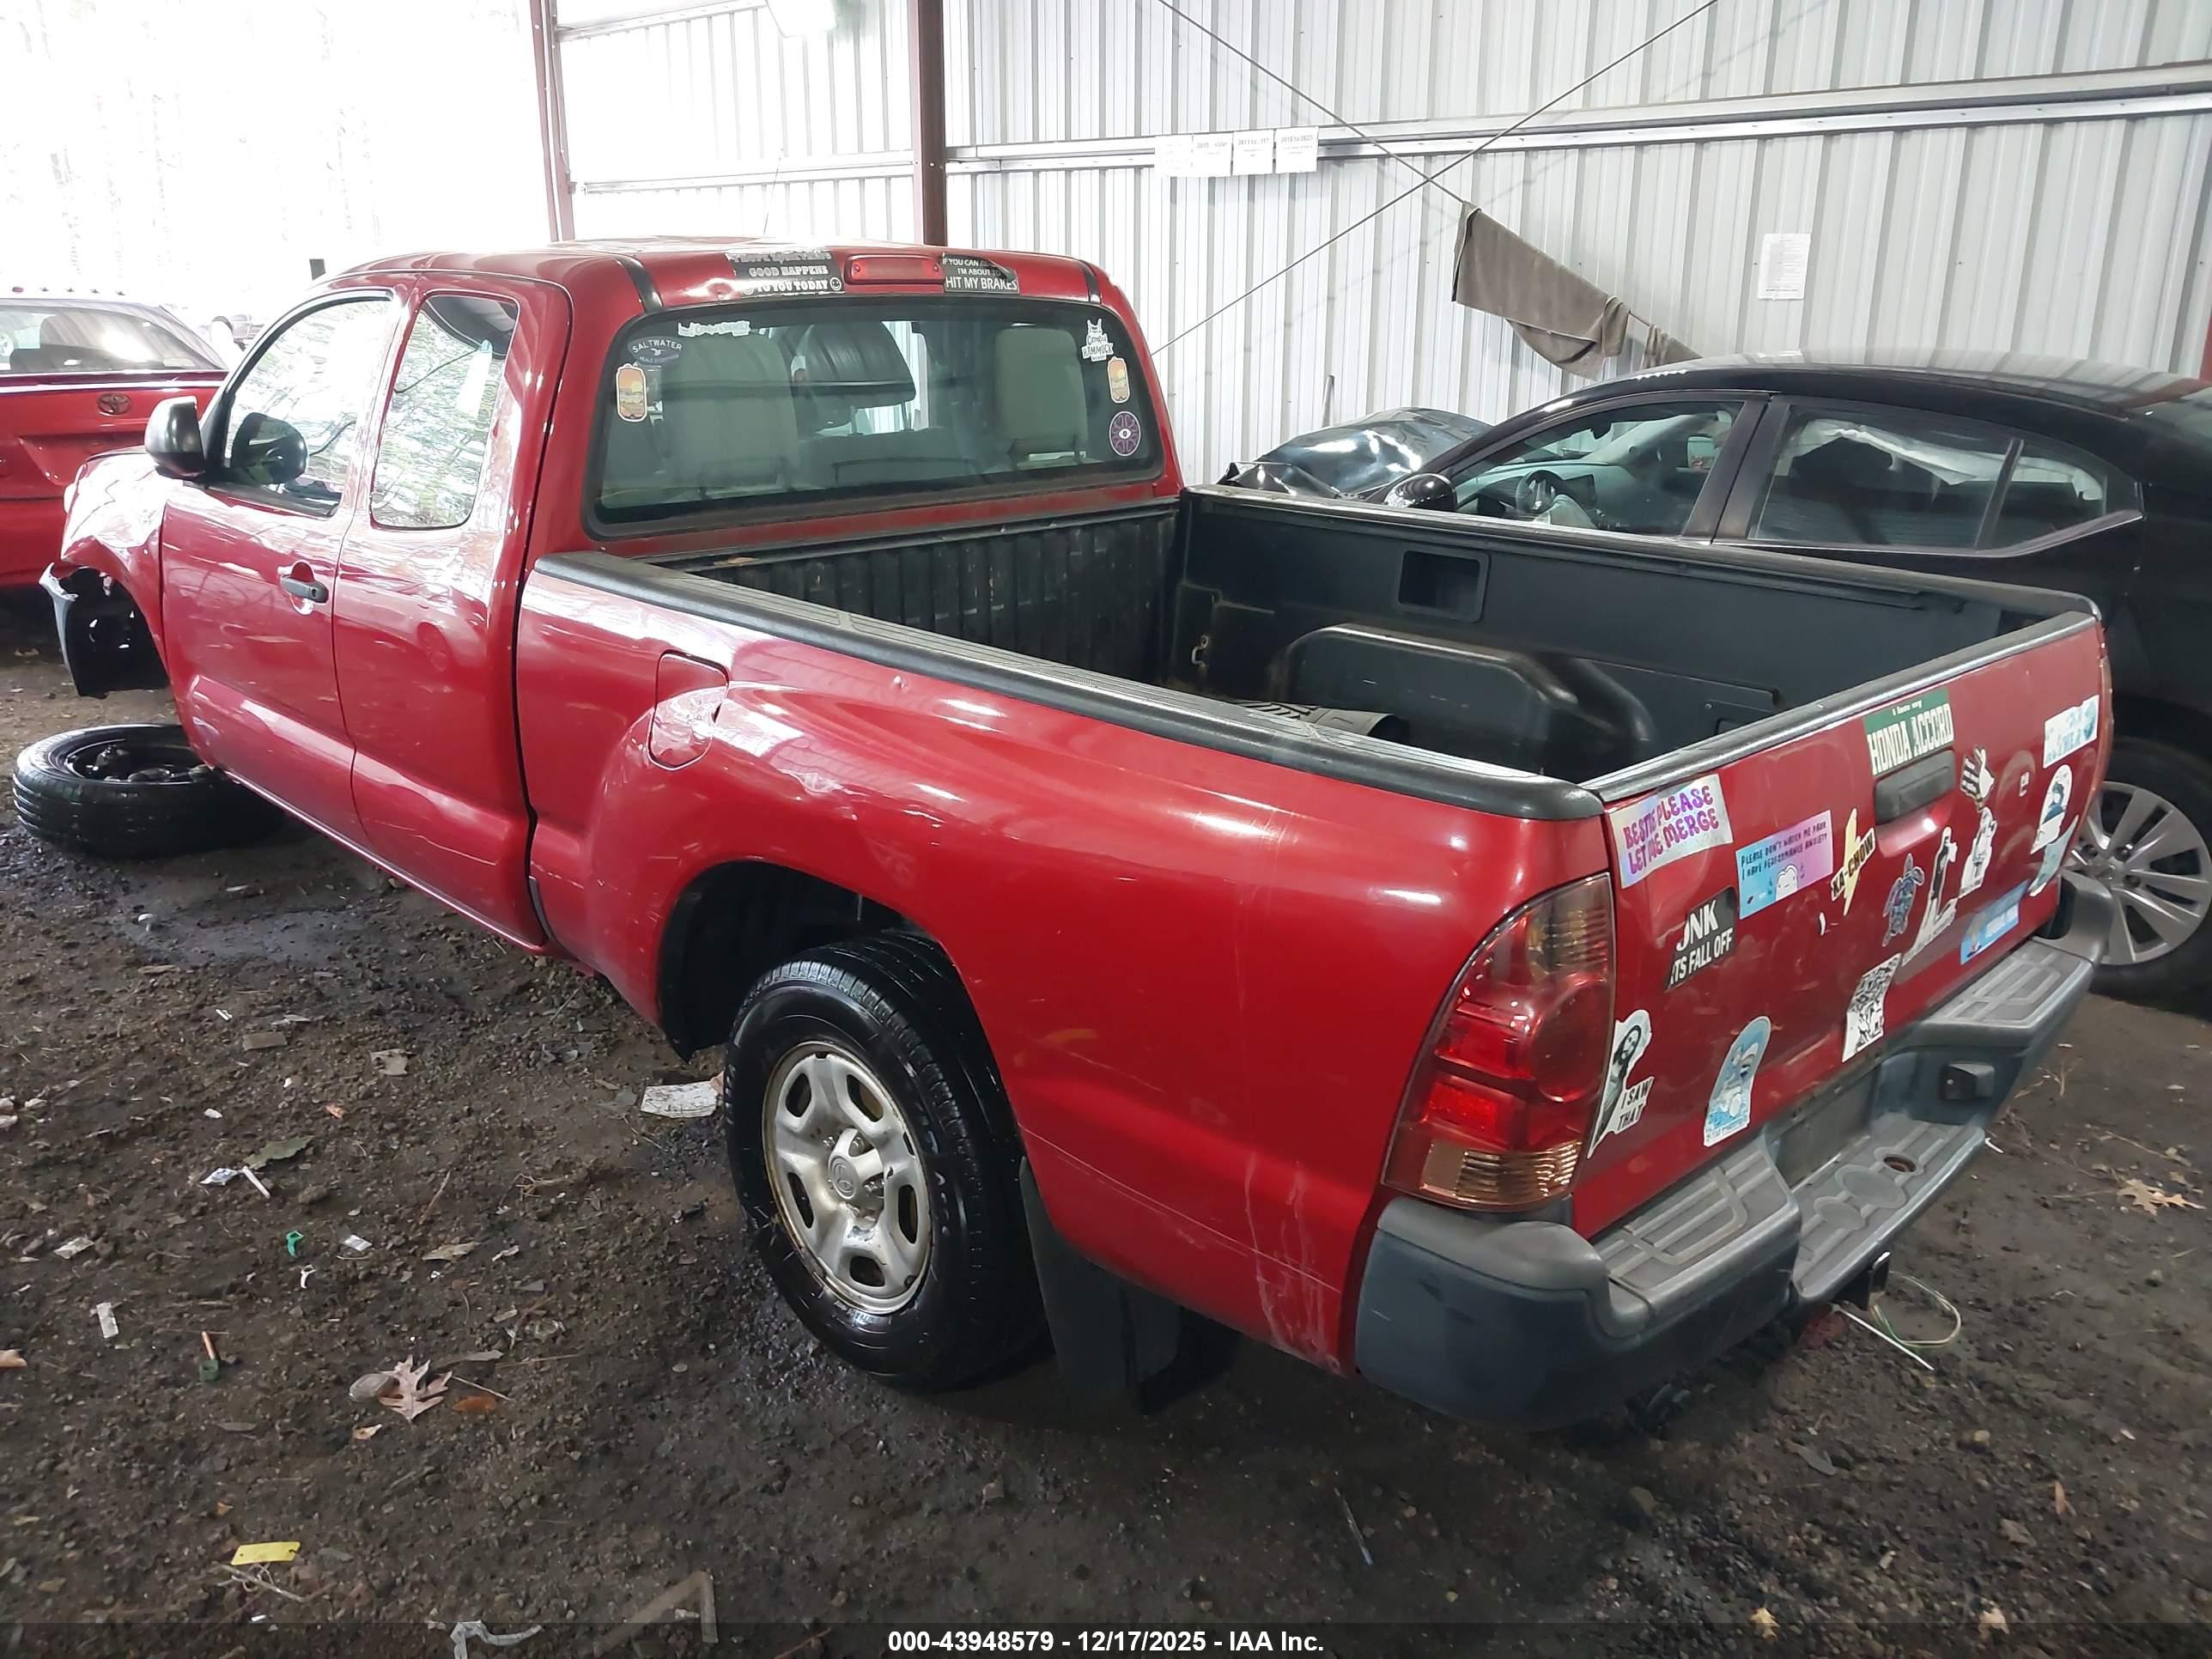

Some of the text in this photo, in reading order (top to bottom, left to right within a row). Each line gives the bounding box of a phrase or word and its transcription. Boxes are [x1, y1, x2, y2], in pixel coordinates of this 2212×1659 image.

[748, 267, 780, 276] GOOD
[772, 281, 793, 292] YOU
[793, 279, 829, 291] TODAY
[945, 276, 962, 289] HIT
[963, 276, 979, 289] MY
[632, 338, 683, 353] SALTWATER
[1867, 703, 1954, 775] HONDA ACCORD
[1623, 786, 1713, 849] BESTIE PLEASE
[1628, 808, 1719, 874] LET ME MERGE
[1741, 849, 1763, 867] PLEASE
[1832, 832, 1873, 897] KA-CHOW
[1688, 941, 1712, 975] FALL
[1713, 927, 1734, 958] OFF
[1618, 1103, 1644, 1131] THAT
